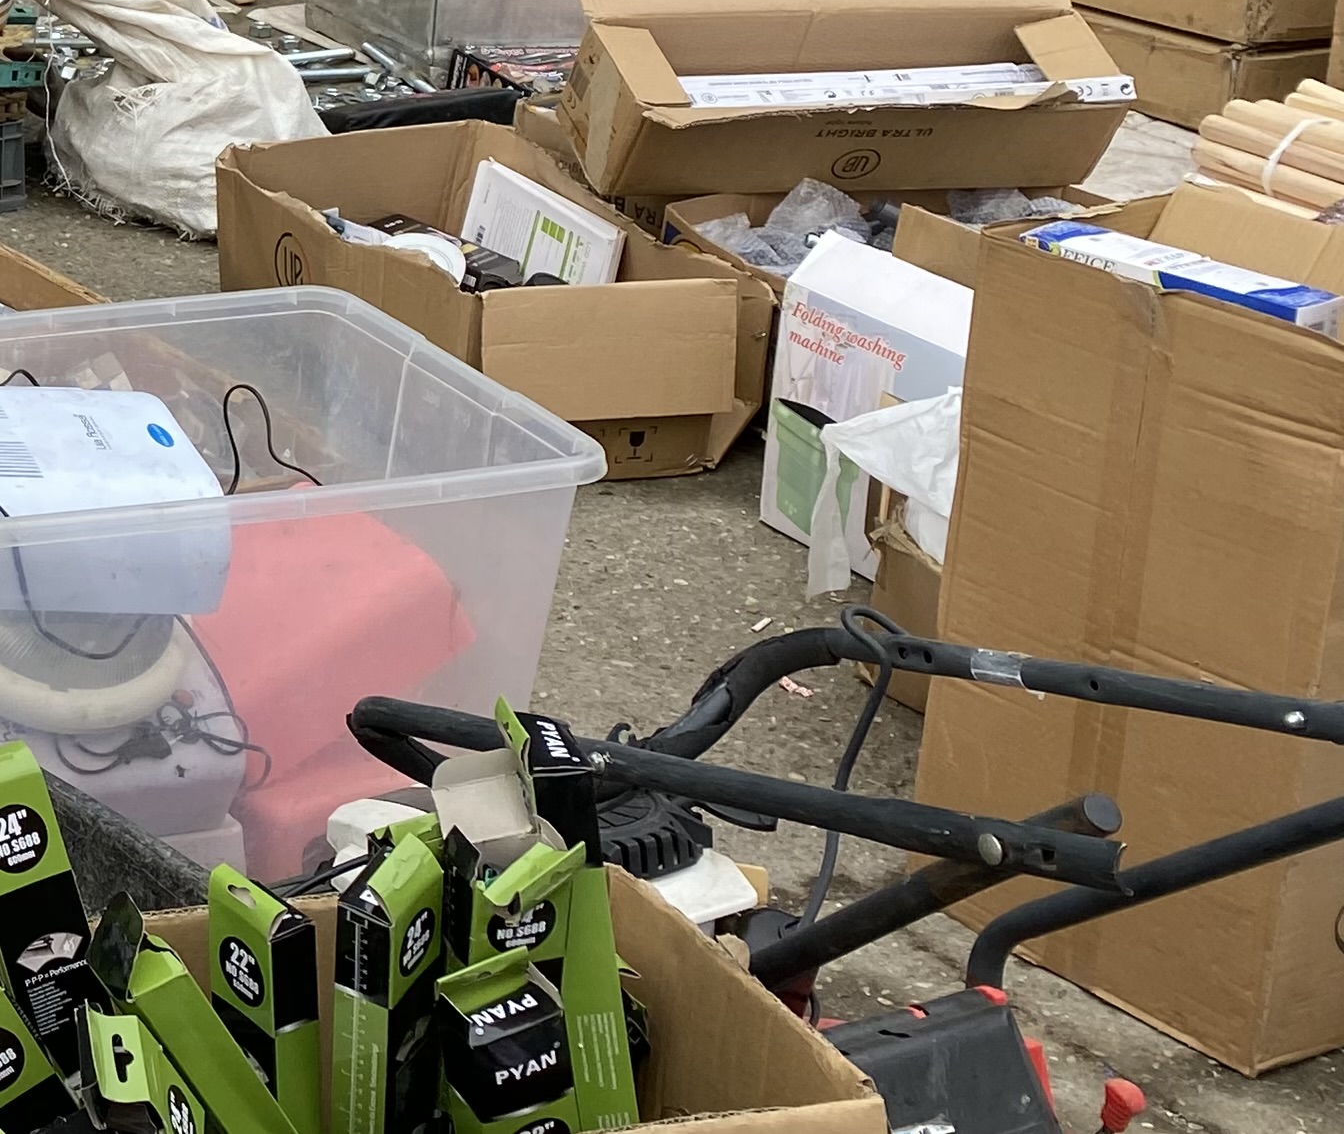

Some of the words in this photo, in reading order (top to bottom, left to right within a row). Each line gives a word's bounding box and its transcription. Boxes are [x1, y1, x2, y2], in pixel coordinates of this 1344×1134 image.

[816, 128, 873, 138] BRIGHT
[876, 127, 933, 138] ULTRA
[790, 331, 845, 366] machine
[792, 302, 845, 343] Folding
[846, 332, 906, 371] washing
[536, 720, 570, 759] PYAN
[407, 911, 428, 948] 24"
[230, 942, 255, 973] 22"
[472, 993, 538, 1027] PYAN
[495, 1049, 558, 1086] PYAN
